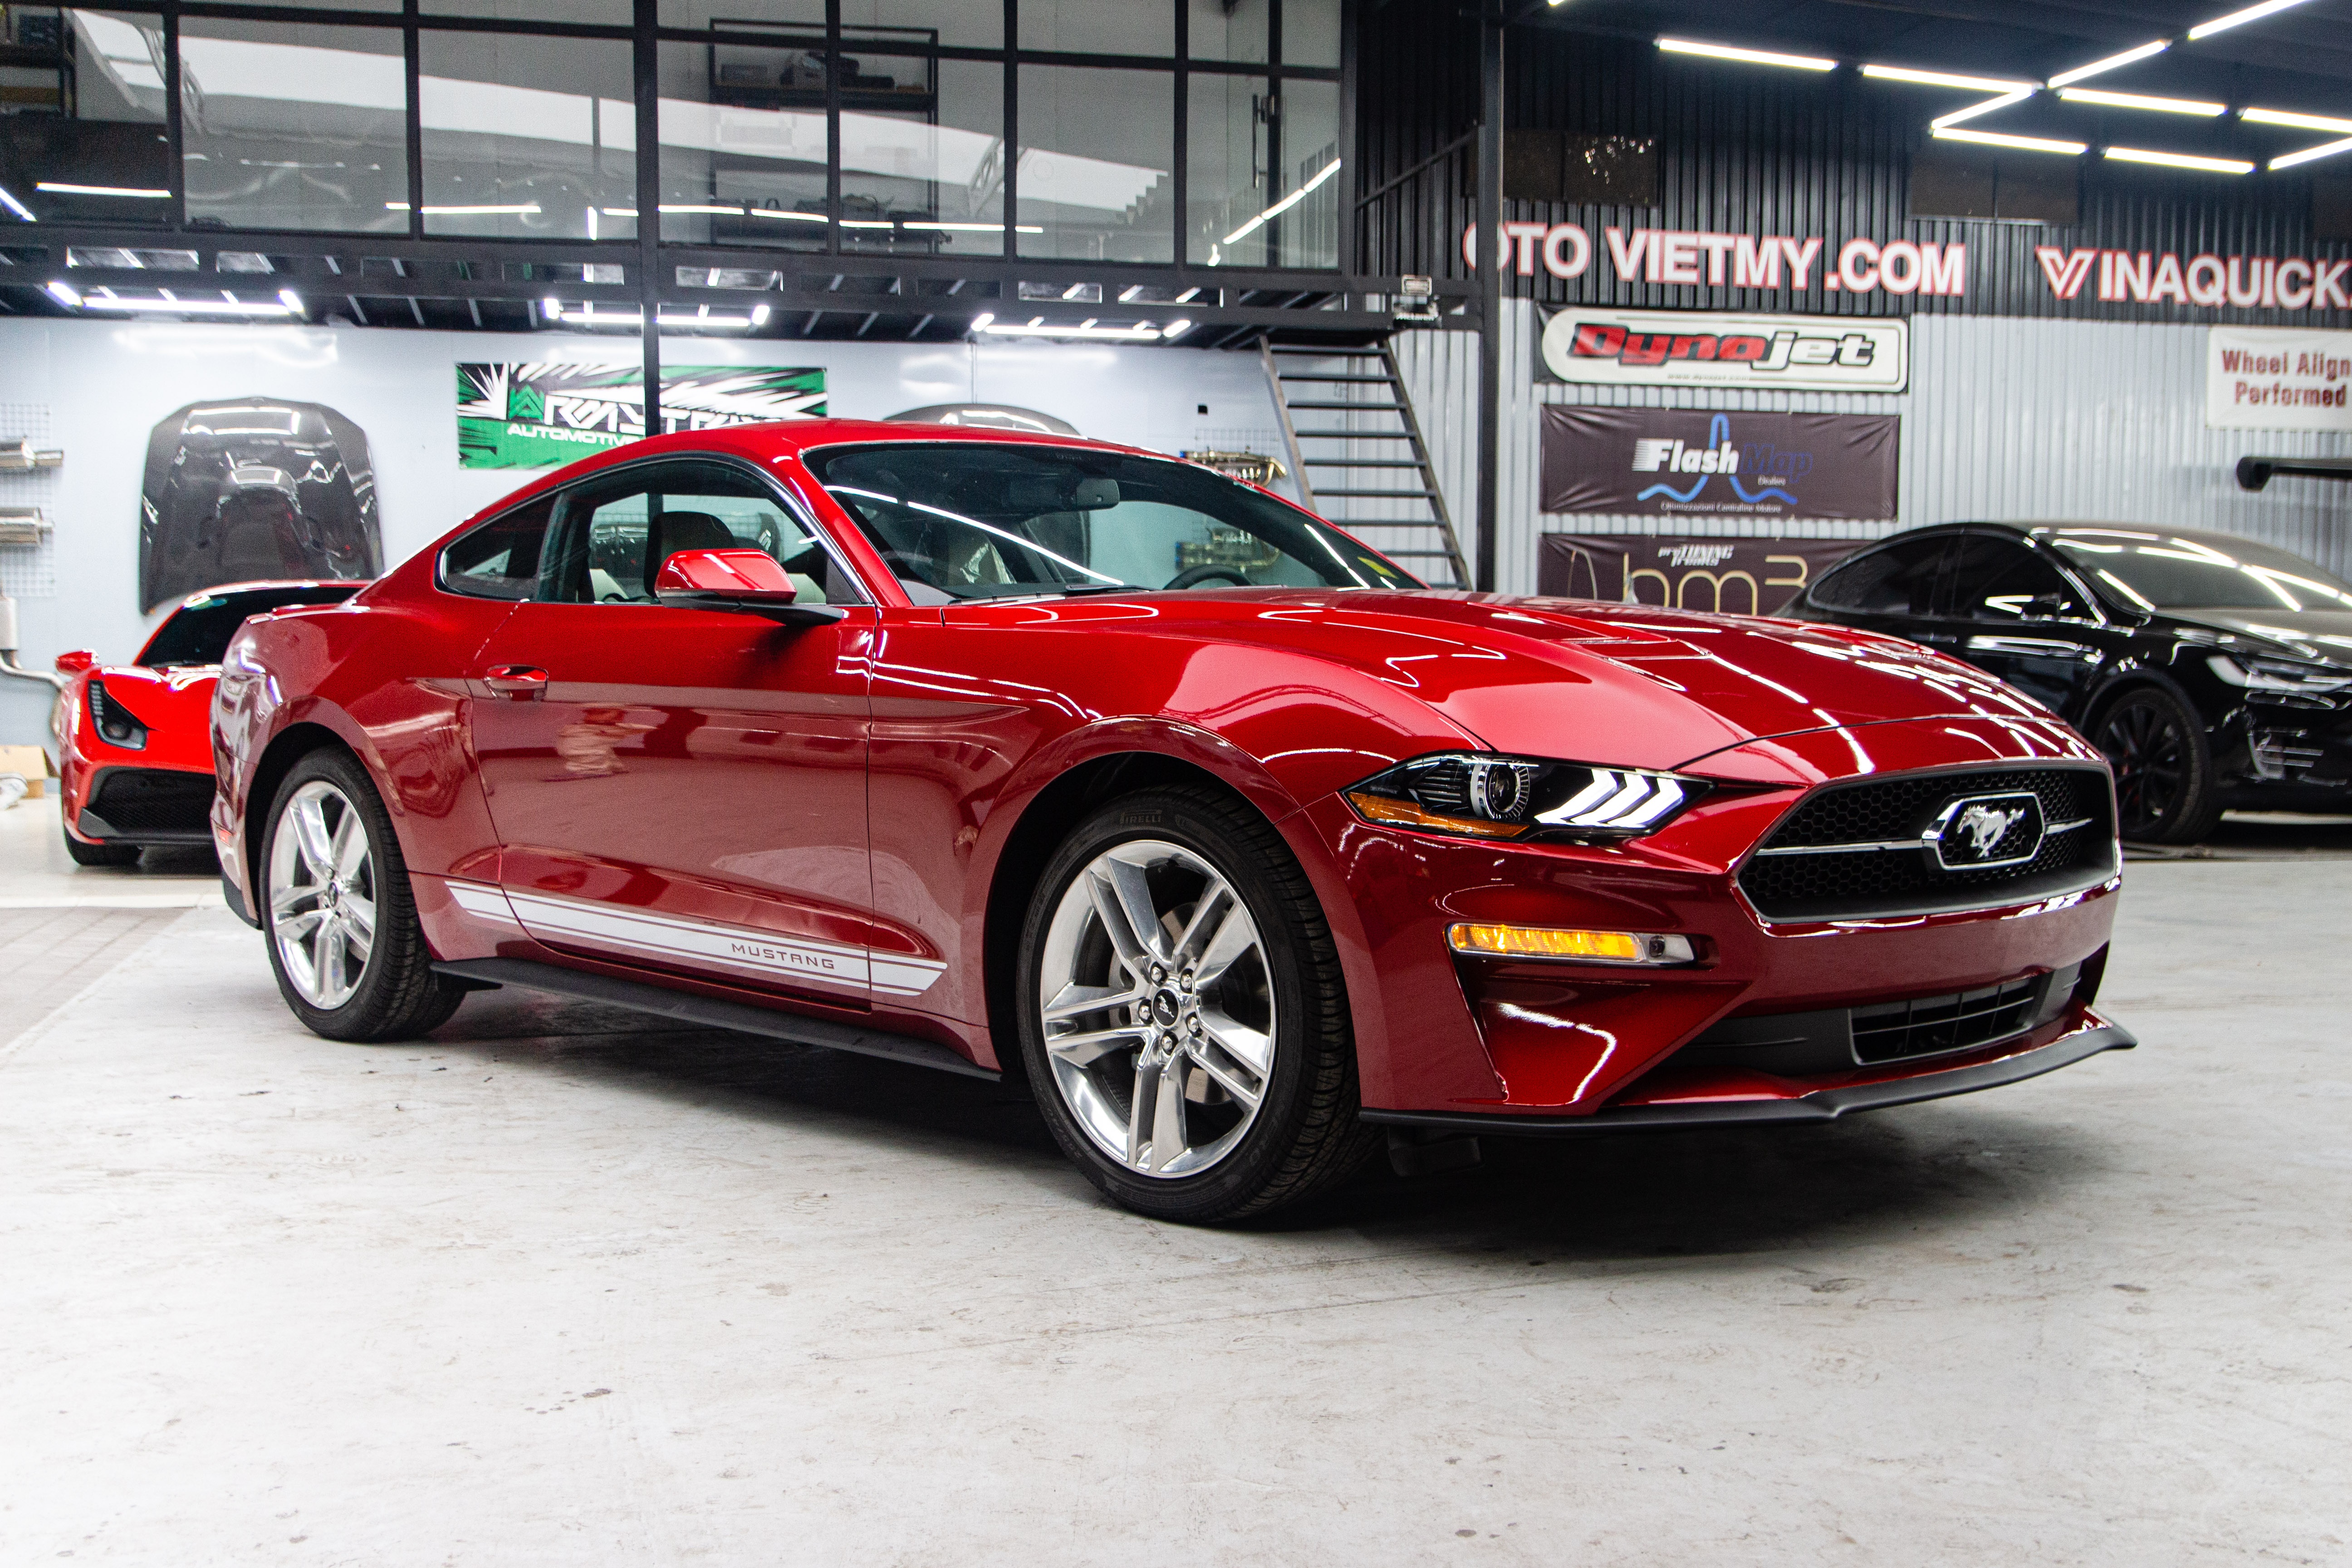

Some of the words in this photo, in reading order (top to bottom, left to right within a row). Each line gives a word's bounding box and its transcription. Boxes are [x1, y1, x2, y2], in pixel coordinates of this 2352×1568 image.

[1462, 220, 1591, 279] OTO
[2035, 246, 2352, 309] VINAQUICK
[1568, 323, 1875, 370] Dynojet
[2222, 348, 2288, 374] Wheel
[2296, 351, 2352, 382] Align
[2235, 381, 2347, 407] Performed
[731, 943, 834, 970] MUSTANG
